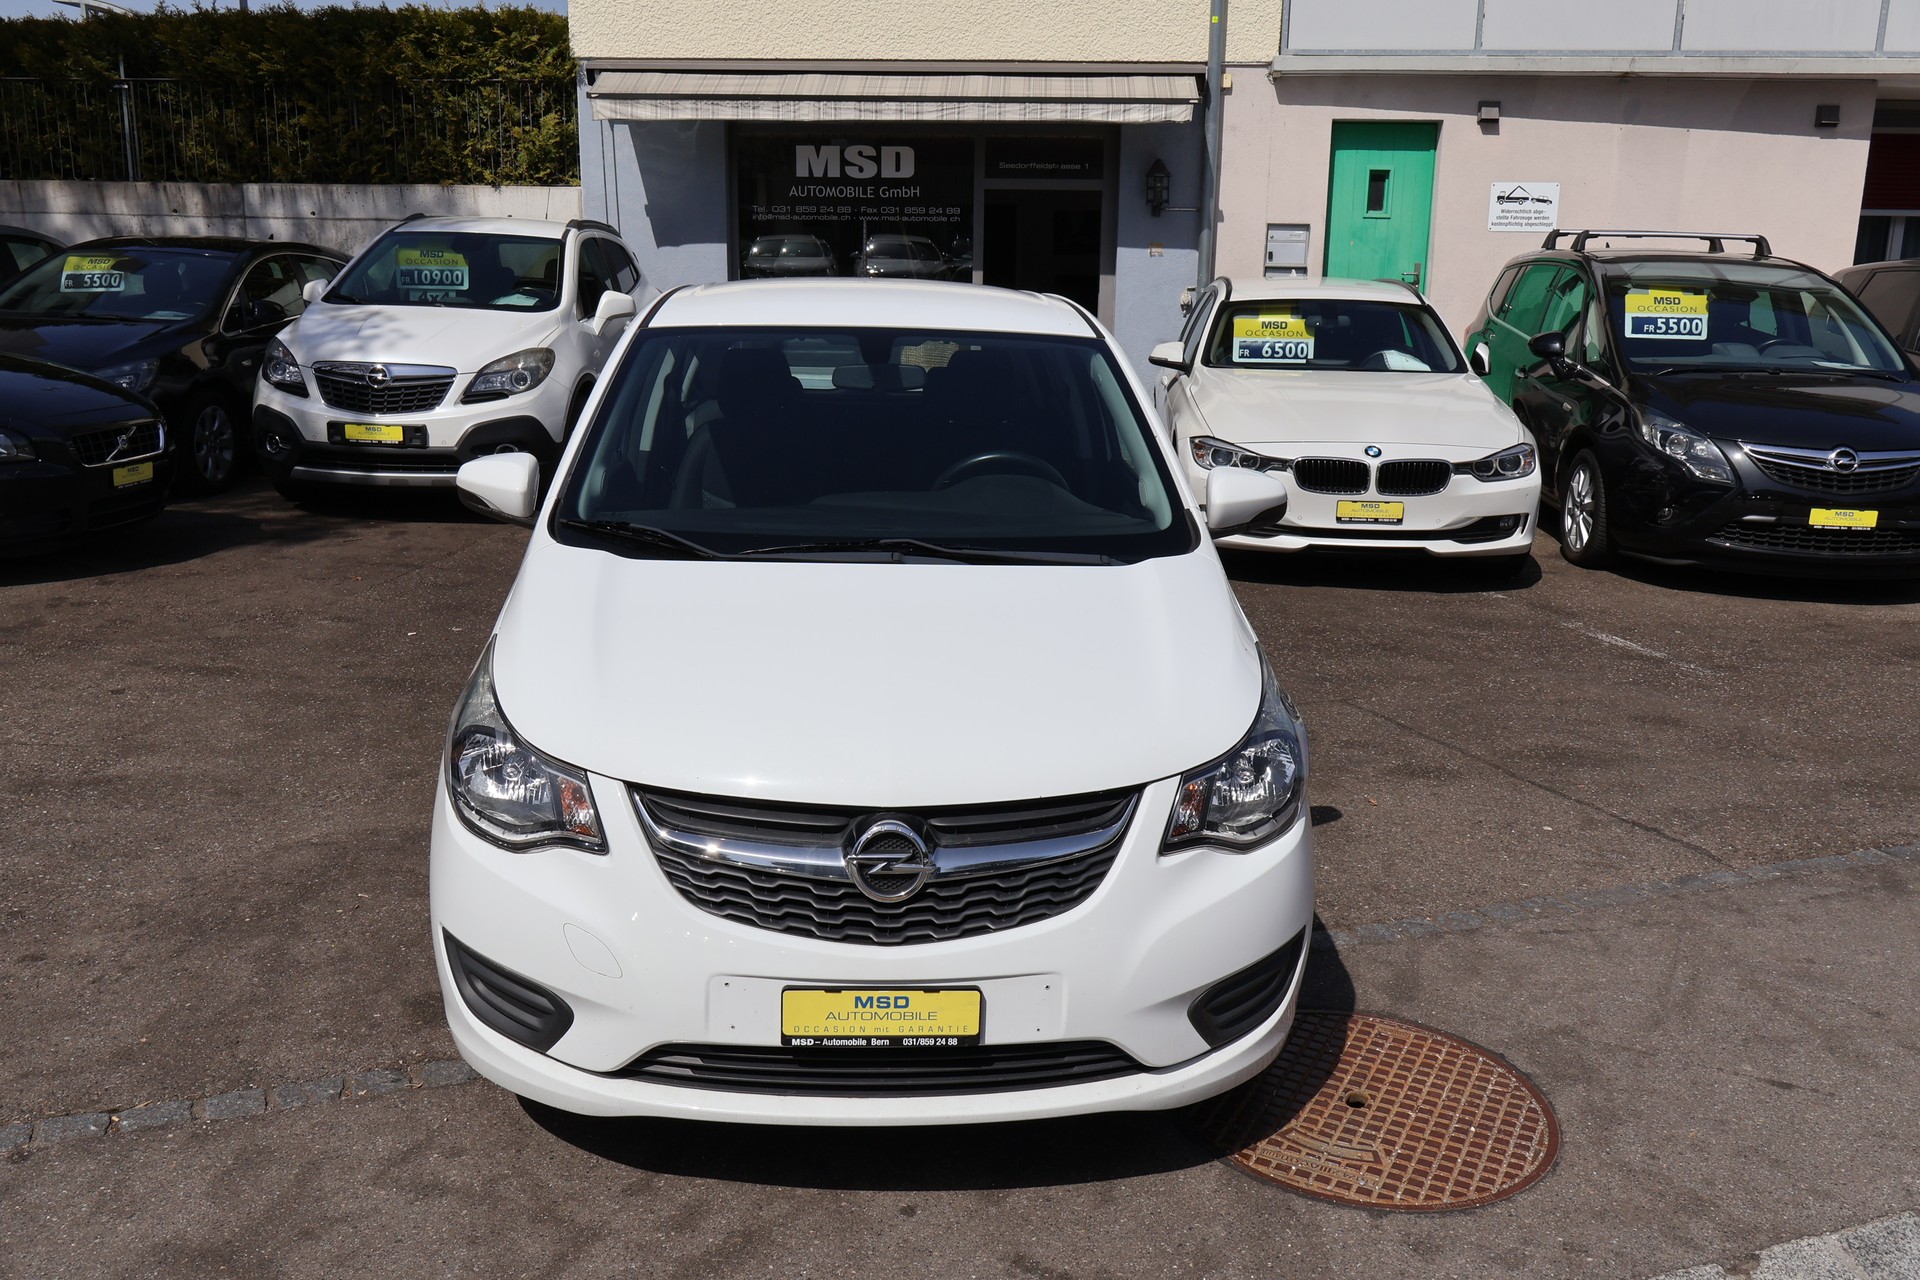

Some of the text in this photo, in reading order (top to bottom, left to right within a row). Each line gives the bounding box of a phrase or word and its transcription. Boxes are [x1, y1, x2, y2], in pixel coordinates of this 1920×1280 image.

[795, 145, 915, 179] MSD
[789, 185, 920, 198] AUTOMOBILE GmbH
[752, 205, 769, 213] Tel.
[772, 205, 791, 213] 031
[881, 206, 900, 214] 031
[946, 207, 961, 215] 89
[420, 250, 444, 258] MSD
[65, 274, 120, 287] FR 5500
[414, 270, 462, 284] 10900
[1653, 296, 1681, 305] MSD
[1637, 305, 1698, 313] OCCASION
[1261, 321, 1288, 329] MSD
[1643, 318, 1702, 334] FR 5500
[1245, 329, 1303, 337] OCCASION
[1239, 342, 1308, 358] FR 6500
[854, 996, 910, 1009] MSD
[825, 1011, 938, 1021] AUTOMOBILE
[793, 1025, 969, 1033] OCCASION mit GARANTIE
[791, 1038, 814, 1046] MSD
[822, 1037, 867, 1046] Automobile
[871, 1037, 890, 1046] Bern
[902, 1037, 935, 1046] 031/859
[935, 1037, 946, 1046] 24
[947, 1037, 958, 1046] 88
